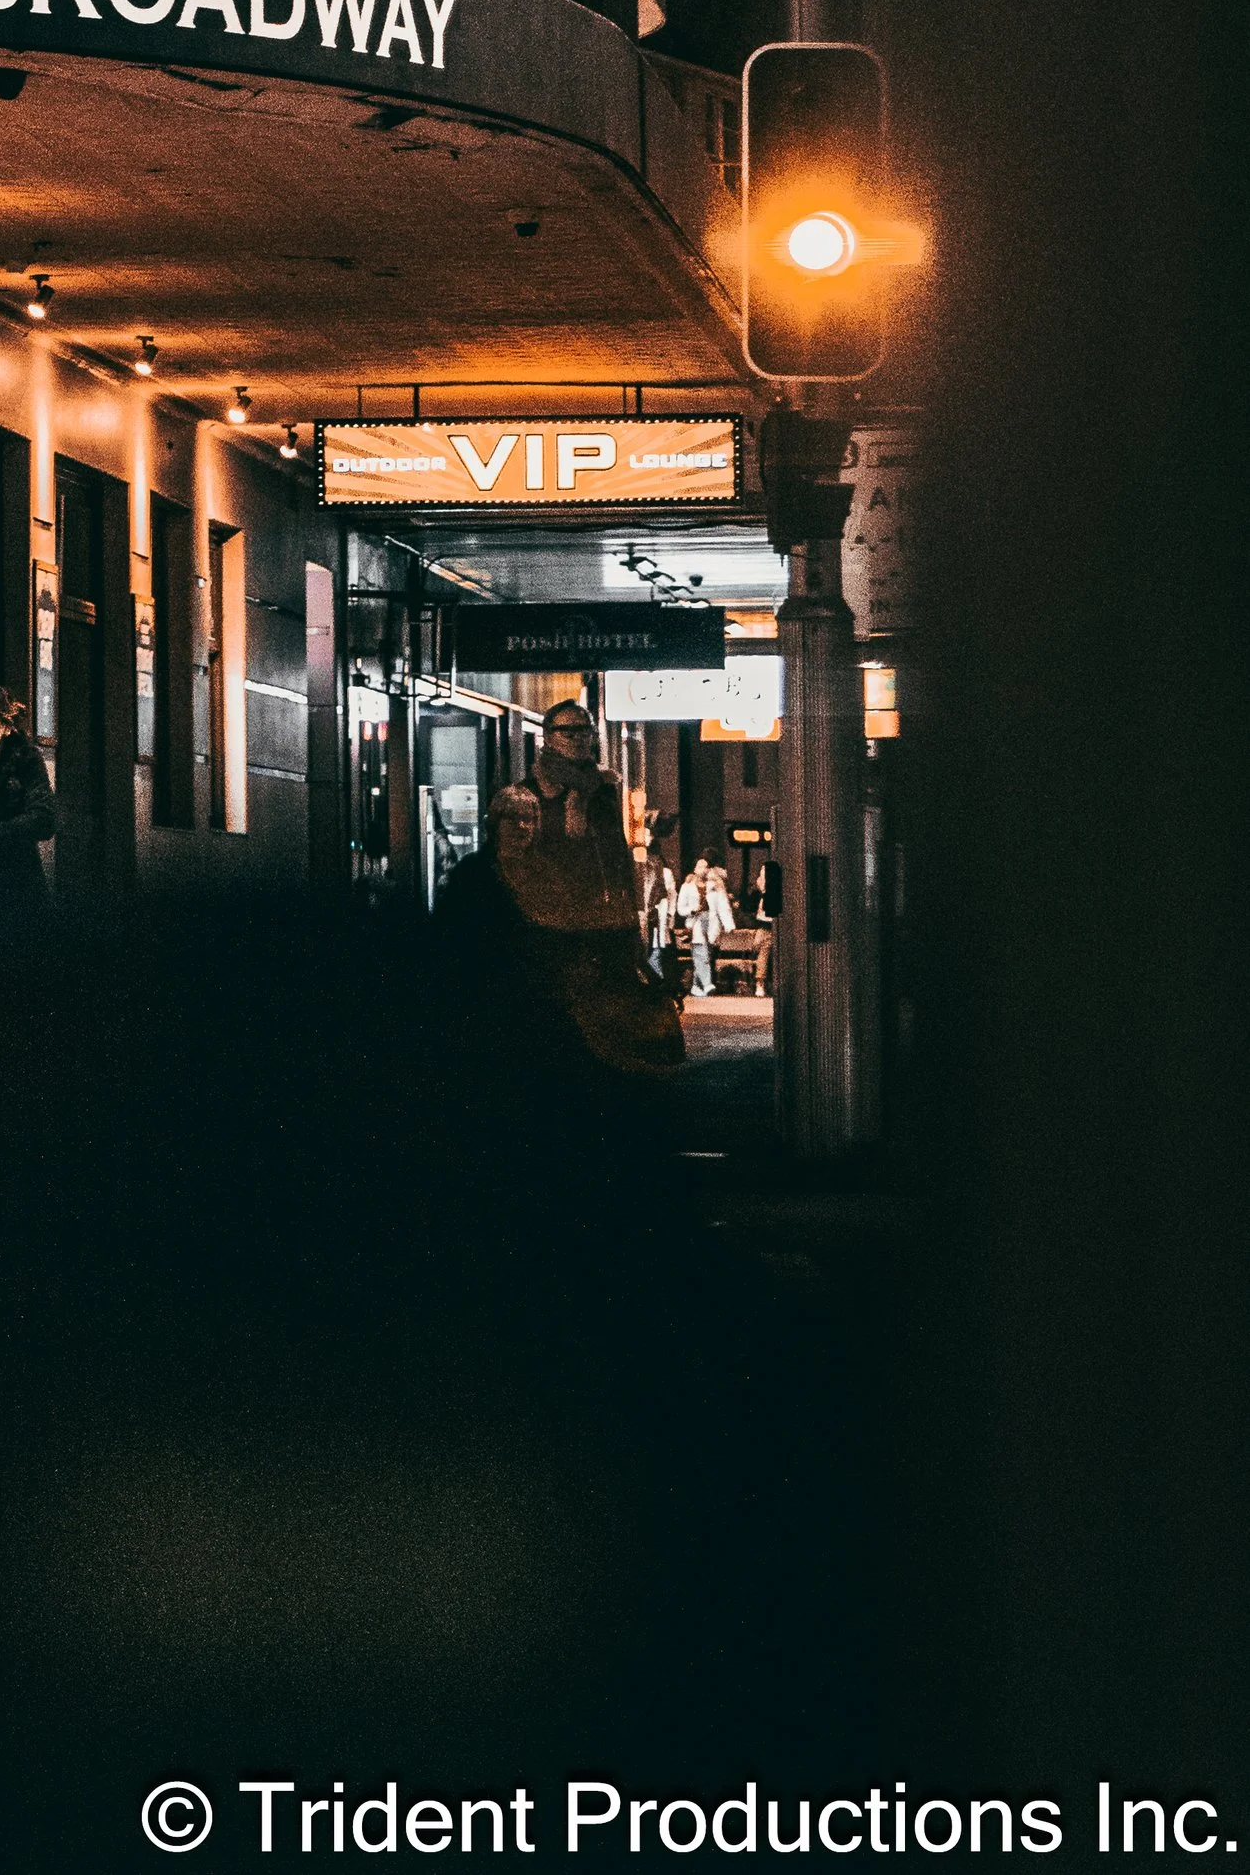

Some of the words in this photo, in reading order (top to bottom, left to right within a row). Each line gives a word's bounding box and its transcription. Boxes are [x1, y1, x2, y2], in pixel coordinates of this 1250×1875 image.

[332, 455, 447, 473] OUTDOOR
[447, 432, 617, 492] VIP
[629, 453, 728, 469] LOUNGE
[578, 633, 658, 650] HOTEL
